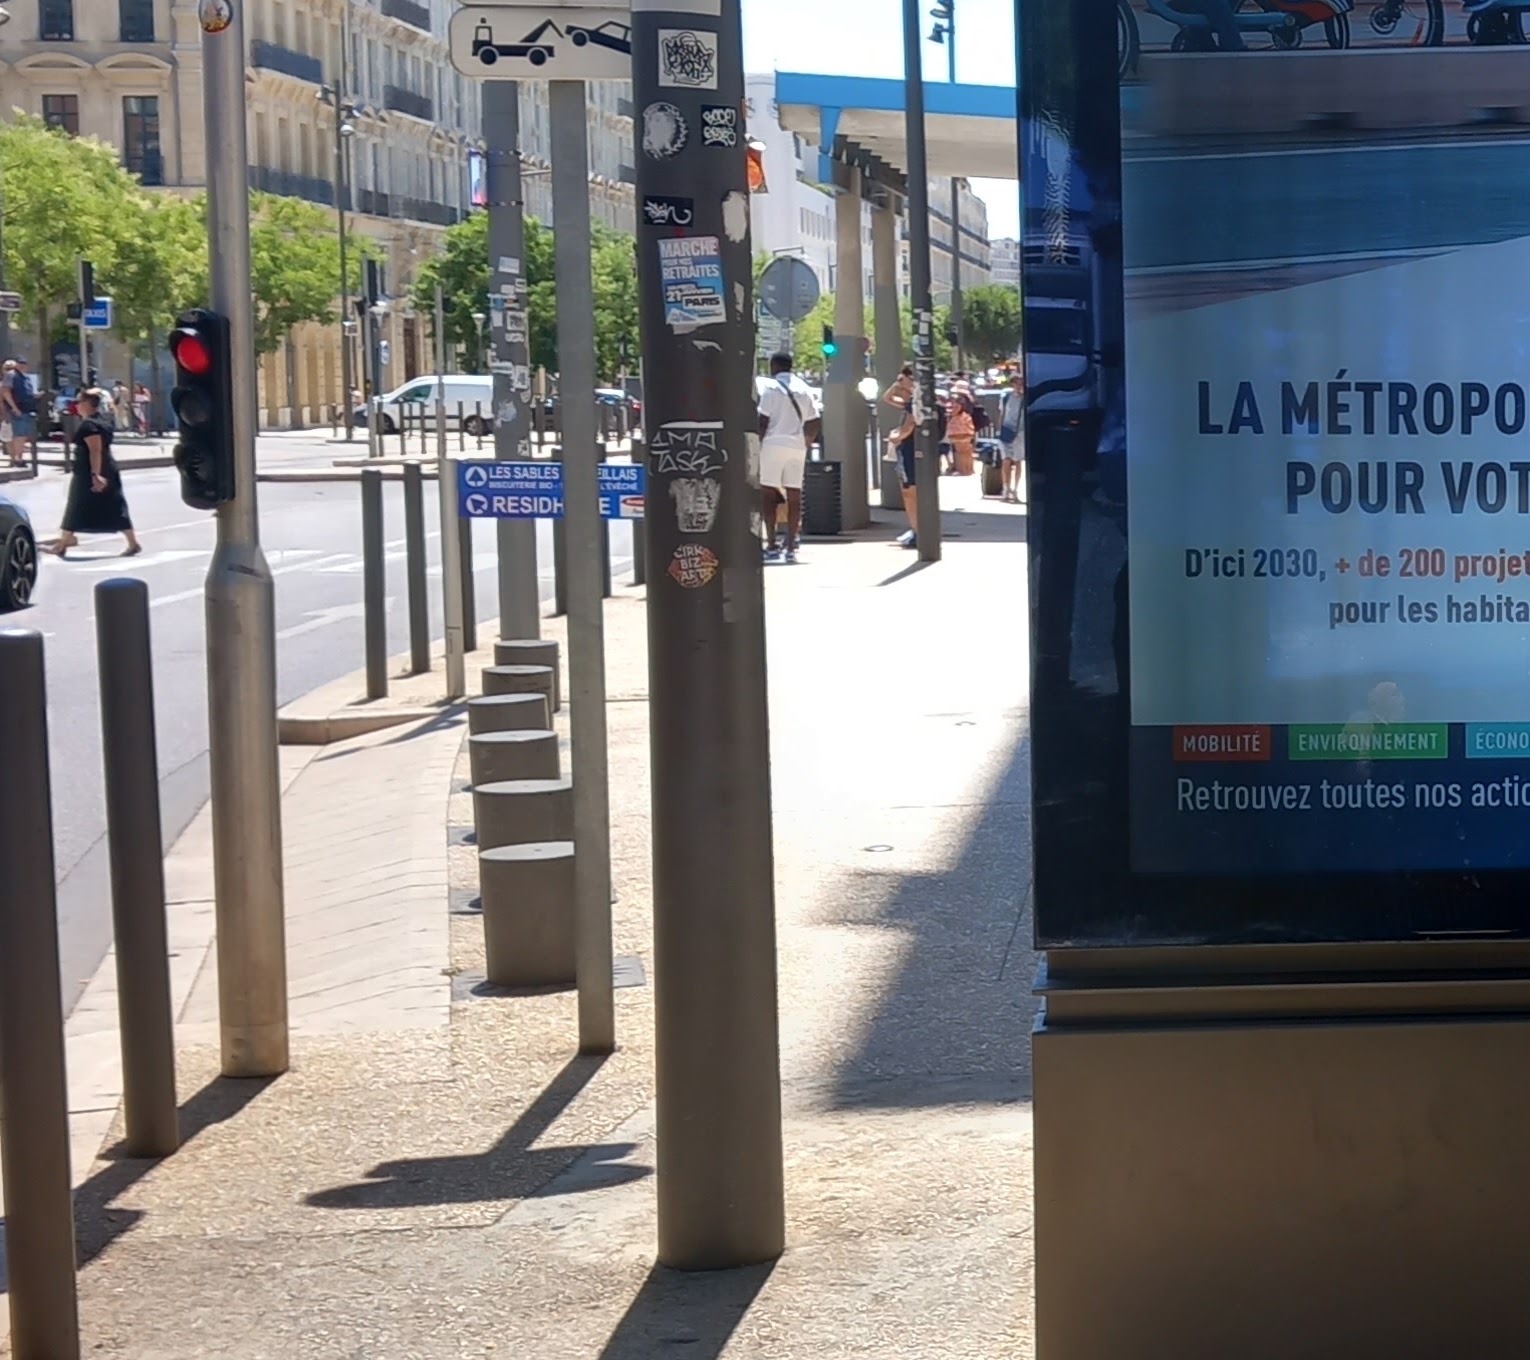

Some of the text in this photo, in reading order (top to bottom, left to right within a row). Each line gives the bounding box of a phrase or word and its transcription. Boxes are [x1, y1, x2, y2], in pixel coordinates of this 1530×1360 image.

[661, 240, 718, 258] MARCHE
[663, 264, 720, 280] RETRAITES
[684, 297, 720, 307] PARIS
[1198, 381, 1264, 434] LA
[489, 467, 512, 479] LES
[514, 468, 560, 480] SABLES
[1286, 461, 1425, 515] POUR
[1184, 548, 1245, 578] D'ici
[1252, 548, 1326, 582] 2030,
[1358, 548, 1391, 577] de
[1399, 548, 1446, 577] 200
[1329, 601, 1390, 629] pour
[1397, 595, 1438, 623] les
[1183, 731, 1261, 753] MOBILITÉ
[1298, 732, 1438, 751] ENVIRONNEMENT
[1177, 778, 1312, 811] Retrouvez
[1320, 778, 1405, 809] toutes
[1415, 783, 1462, 808] nos
